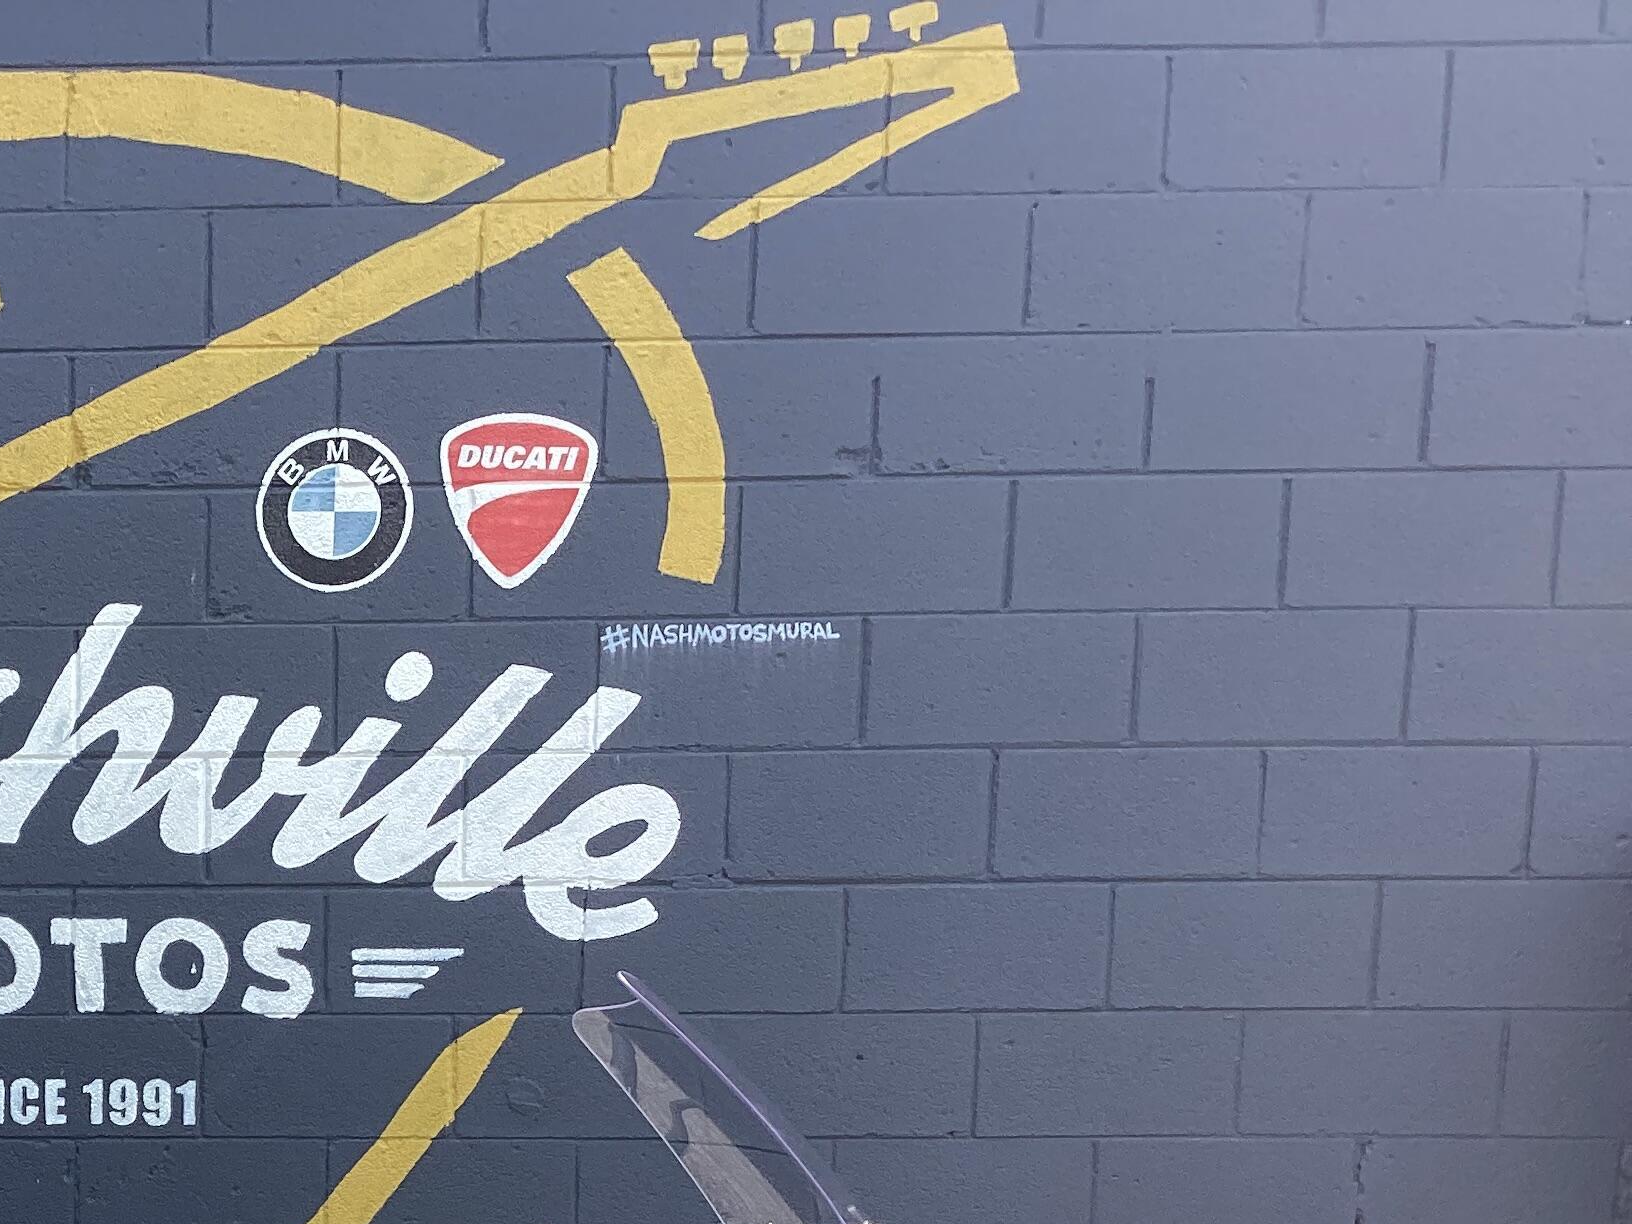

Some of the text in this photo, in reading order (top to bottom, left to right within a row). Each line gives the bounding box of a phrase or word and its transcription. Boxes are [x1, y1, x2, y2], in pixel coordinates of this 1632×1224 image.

[277, 439, 396, 486] BMW
[457, 444, 579, 472] DUCATI
[600, 622, 840, 653] #NASHMOTOSMURAL
[82, 1078, 197, 1126] 1991
